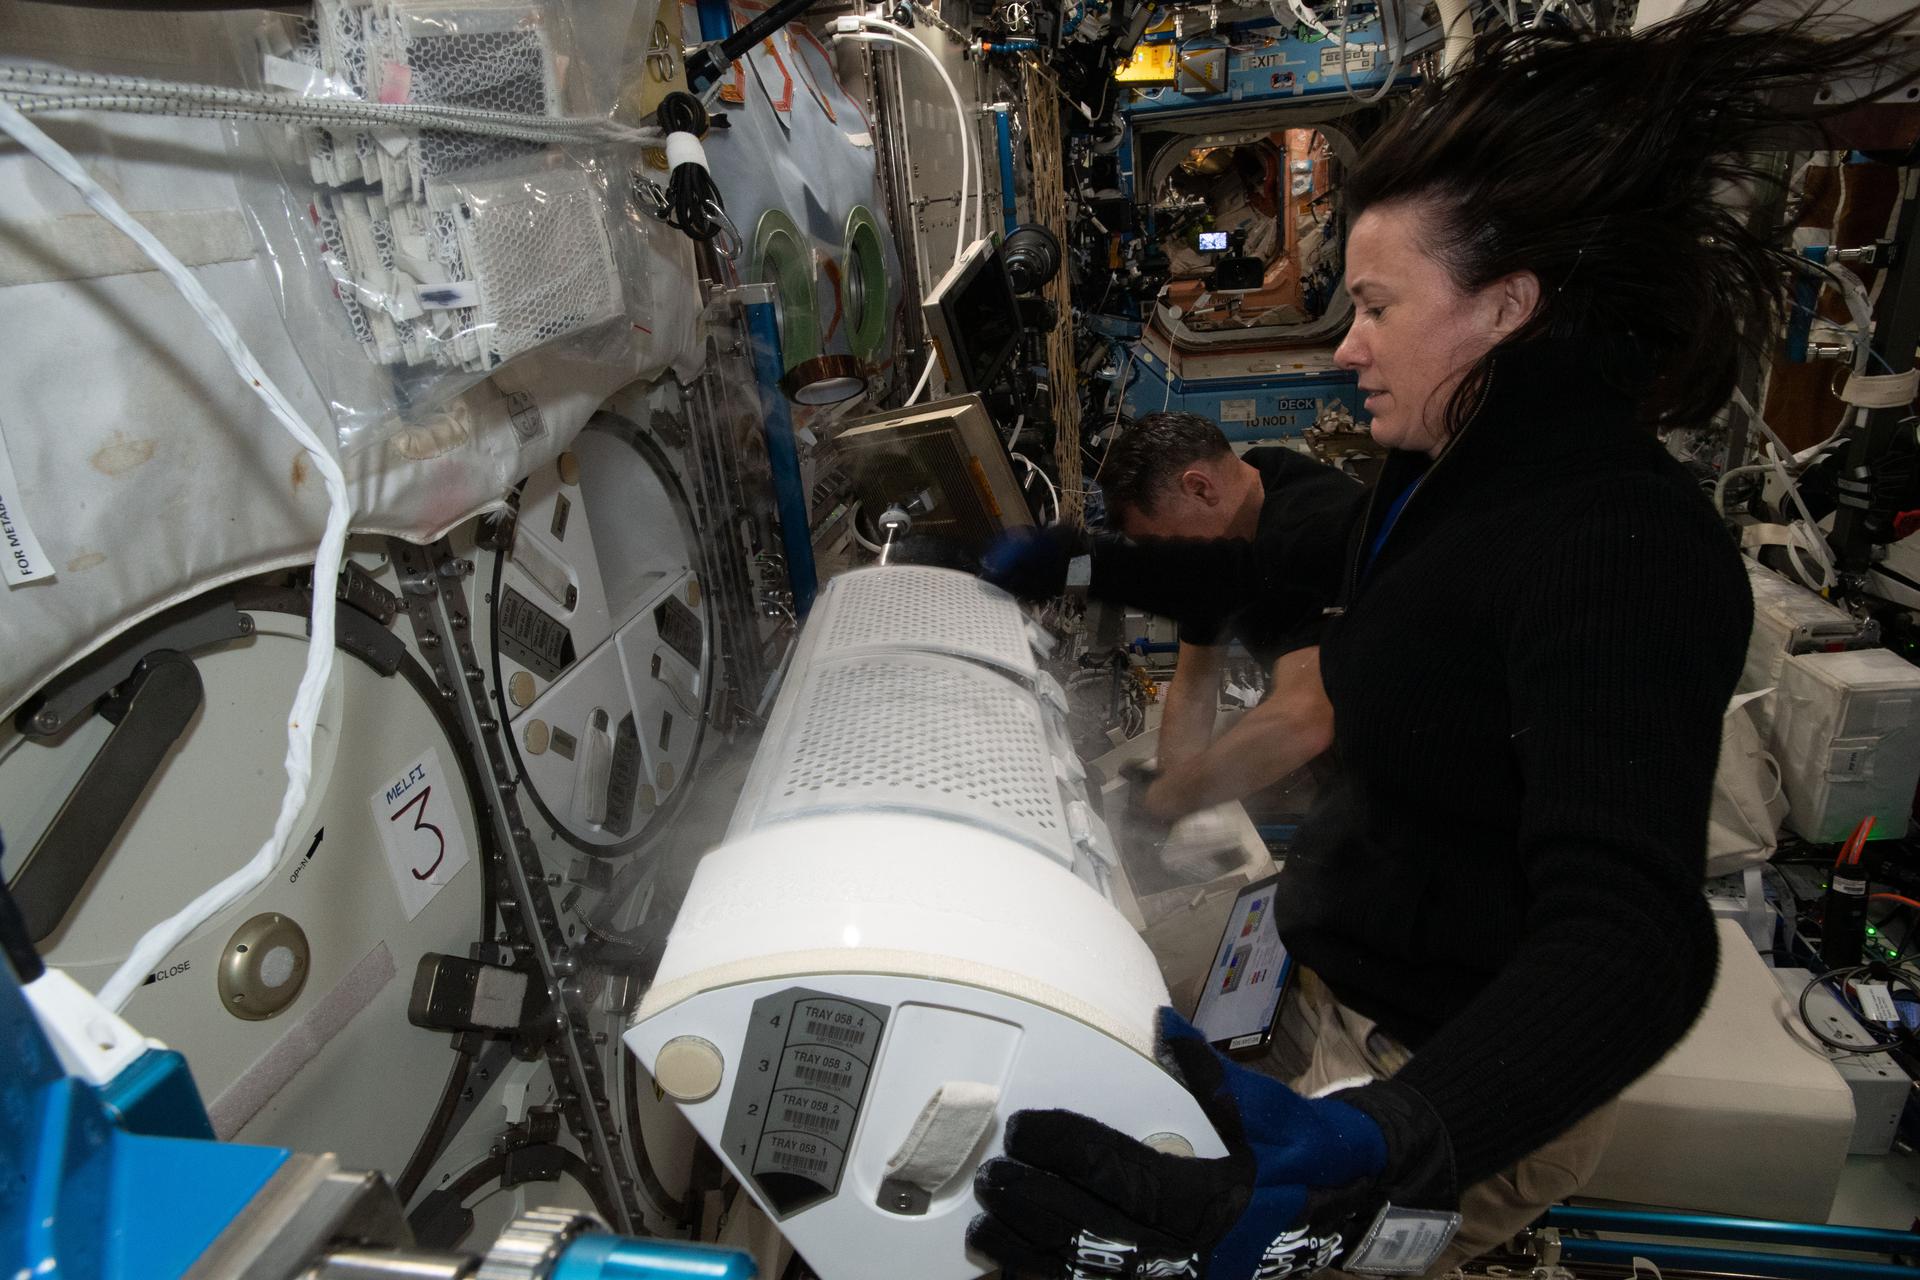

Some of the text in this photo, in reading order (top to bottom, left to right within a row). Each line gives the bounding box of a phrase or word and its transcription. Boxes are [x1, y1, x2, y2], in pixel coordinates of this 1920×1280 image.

[1248, 54, 1279, 69] EXIT
[1280, 400, 1313, 410] DECK
[1262, 415, 1287, 427] NOD
[1290, 415, 1295, 425] 1
[14, 550, 33, 576] FOR
[385, 763, 426, 805] MELFI
[390, 785, 445, 881] 3
[156, 960, 191, 981] CLOSE
[805, 1006, 833, 1021] TRAY
[769, 1015, 781, 1028] 4
[794, 1050, 821, 1065] TRAY
[757, 1059, 769, 1072] 3
[783, 1094, 808, 1108] TRAY
[747, 1103, 759, 1116] 2
[739, 1144, 746, 1155] 1
[772, 1136, 798, 1150] TRAY
